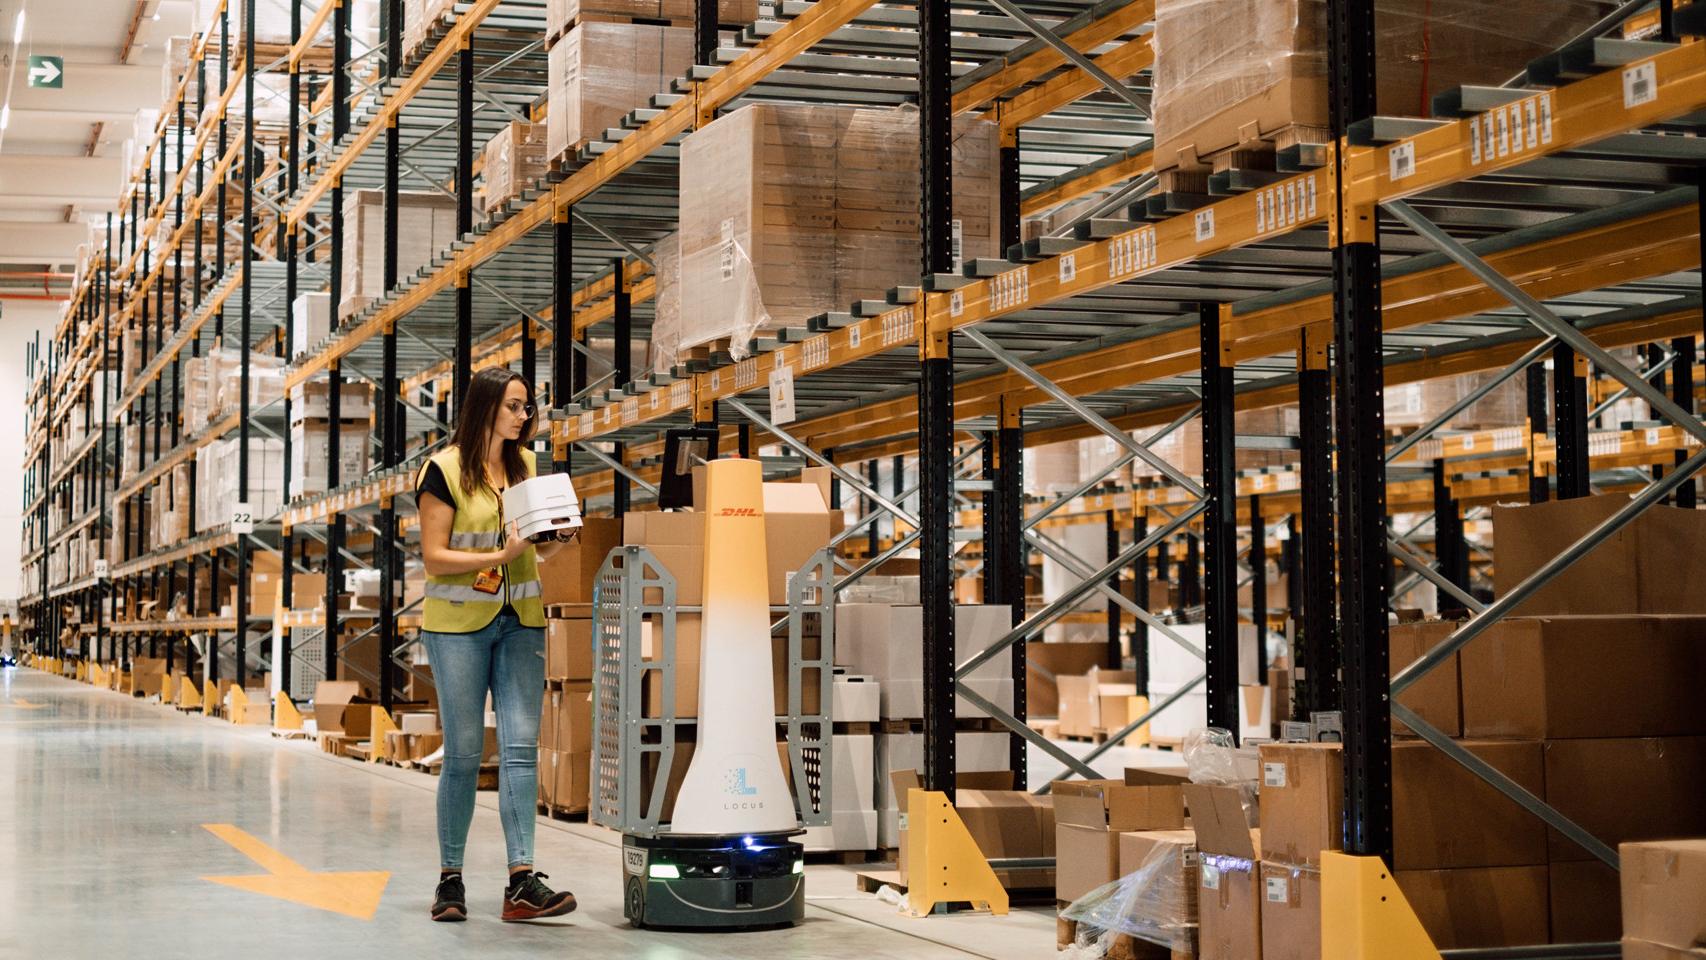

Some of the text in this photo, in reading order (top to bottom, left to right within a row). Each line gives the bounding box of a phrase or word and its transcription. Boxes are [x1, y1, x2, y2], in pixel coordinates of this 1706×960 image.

[720, 507, 758, 517] DHL
[234, 512, 251, 523] 22
[723, 801, 764, 810] LOCUS
[627, 851, 643, 867] 19279
